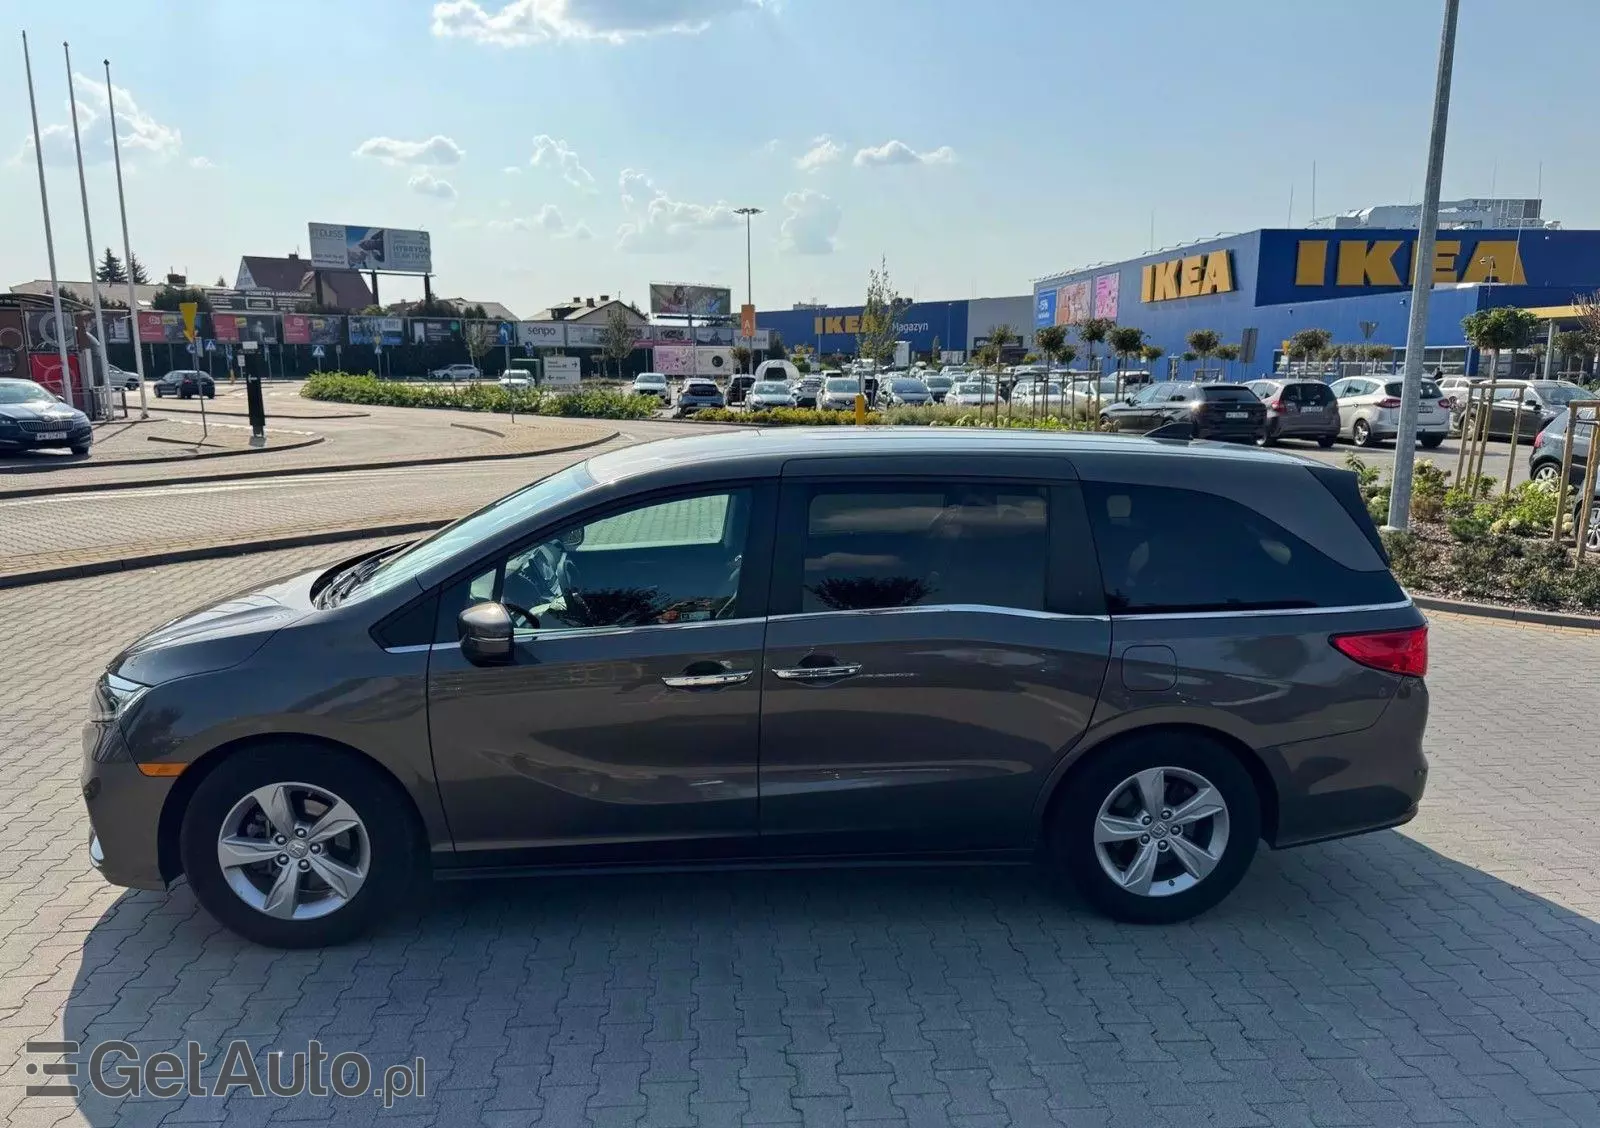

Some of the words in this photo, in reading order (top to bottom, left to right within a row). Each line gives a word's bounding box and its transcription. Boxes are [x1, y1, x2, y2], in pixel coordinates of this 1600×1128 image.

[1141, 248, 1233, 303] IKEA
[1295, 240, 1528, 286] IKEA
[527, 327, 556, 337] senpo
[892, 322, 929, 334] Magazyn
